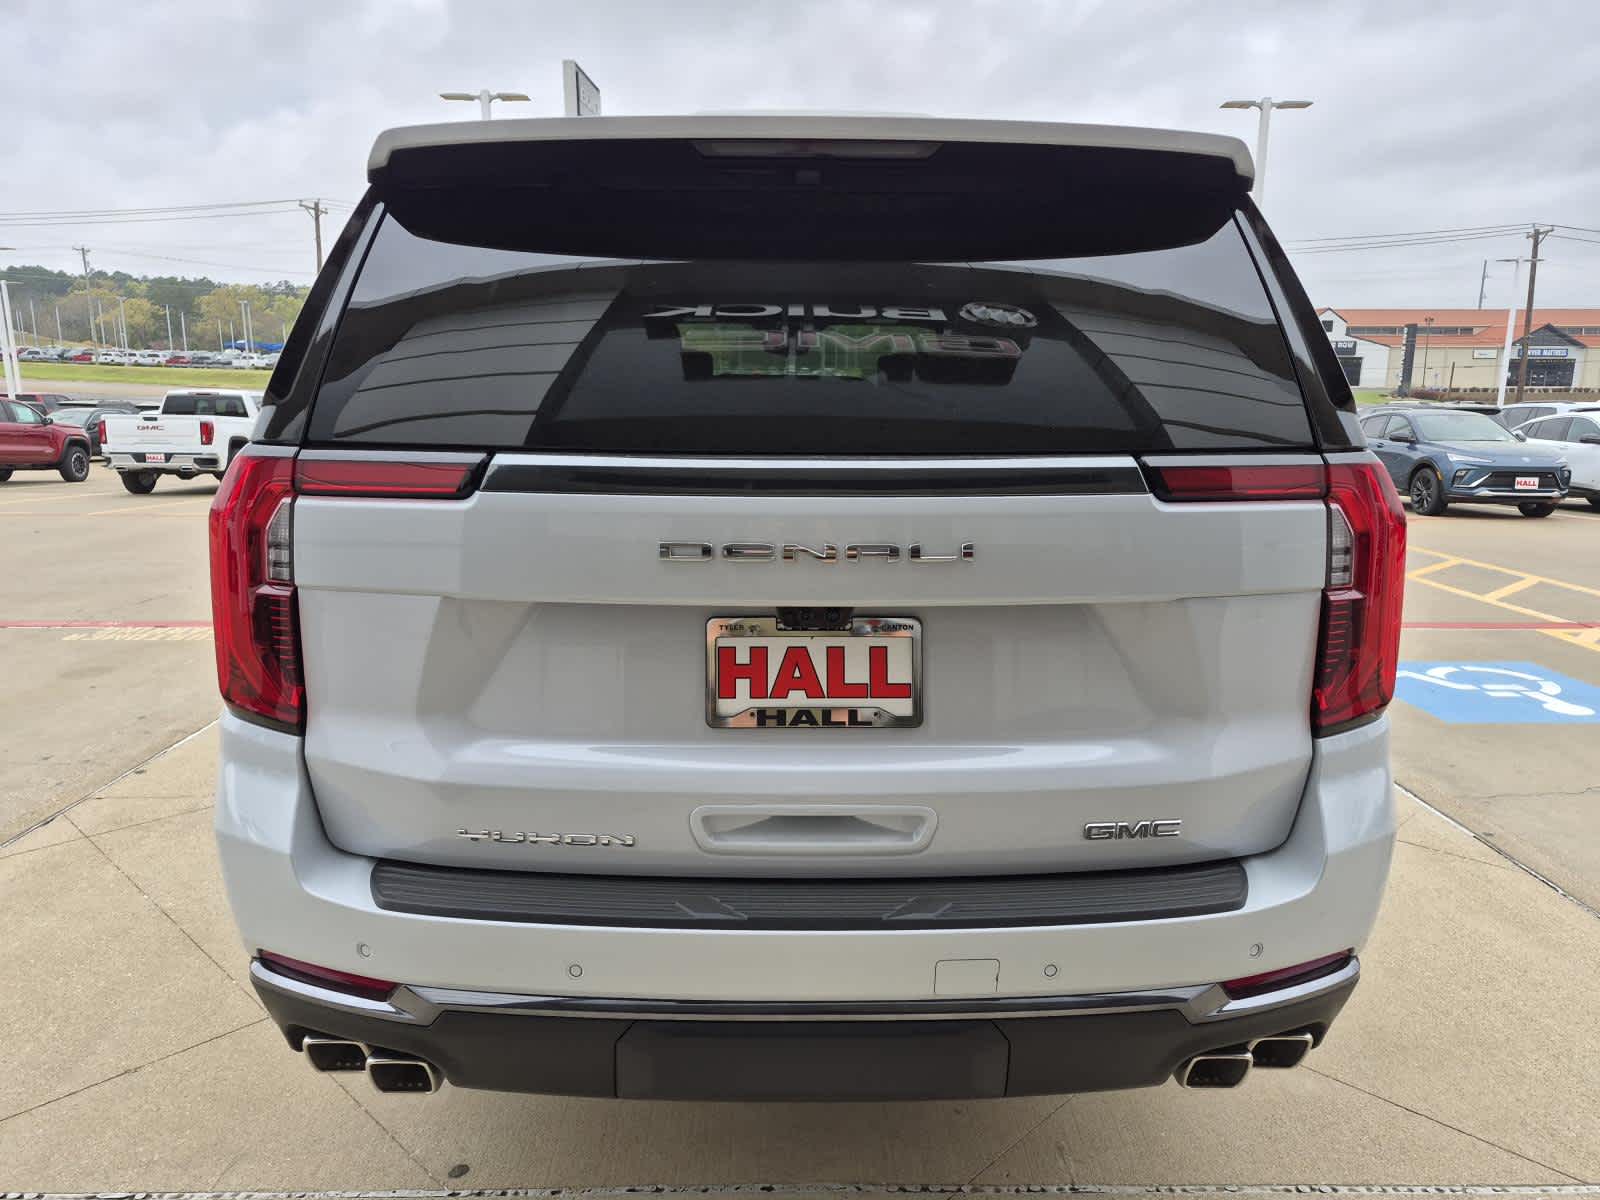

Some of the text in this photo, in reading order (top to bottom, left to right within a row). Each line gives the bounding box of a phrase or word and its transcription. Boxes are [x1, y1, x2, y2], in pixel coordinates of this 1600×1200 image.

[1516, 479, 1537, 487] HALL
[658, 541, 976, 563] DENALI
[881, 623, 914, 631] CANTON
[716, 645, 912, 699] HALL
[755, 708, 873, 726] HALL
[456, 829, 636, 848] YUKON
[1083, 819, 1182, 840] GMC
